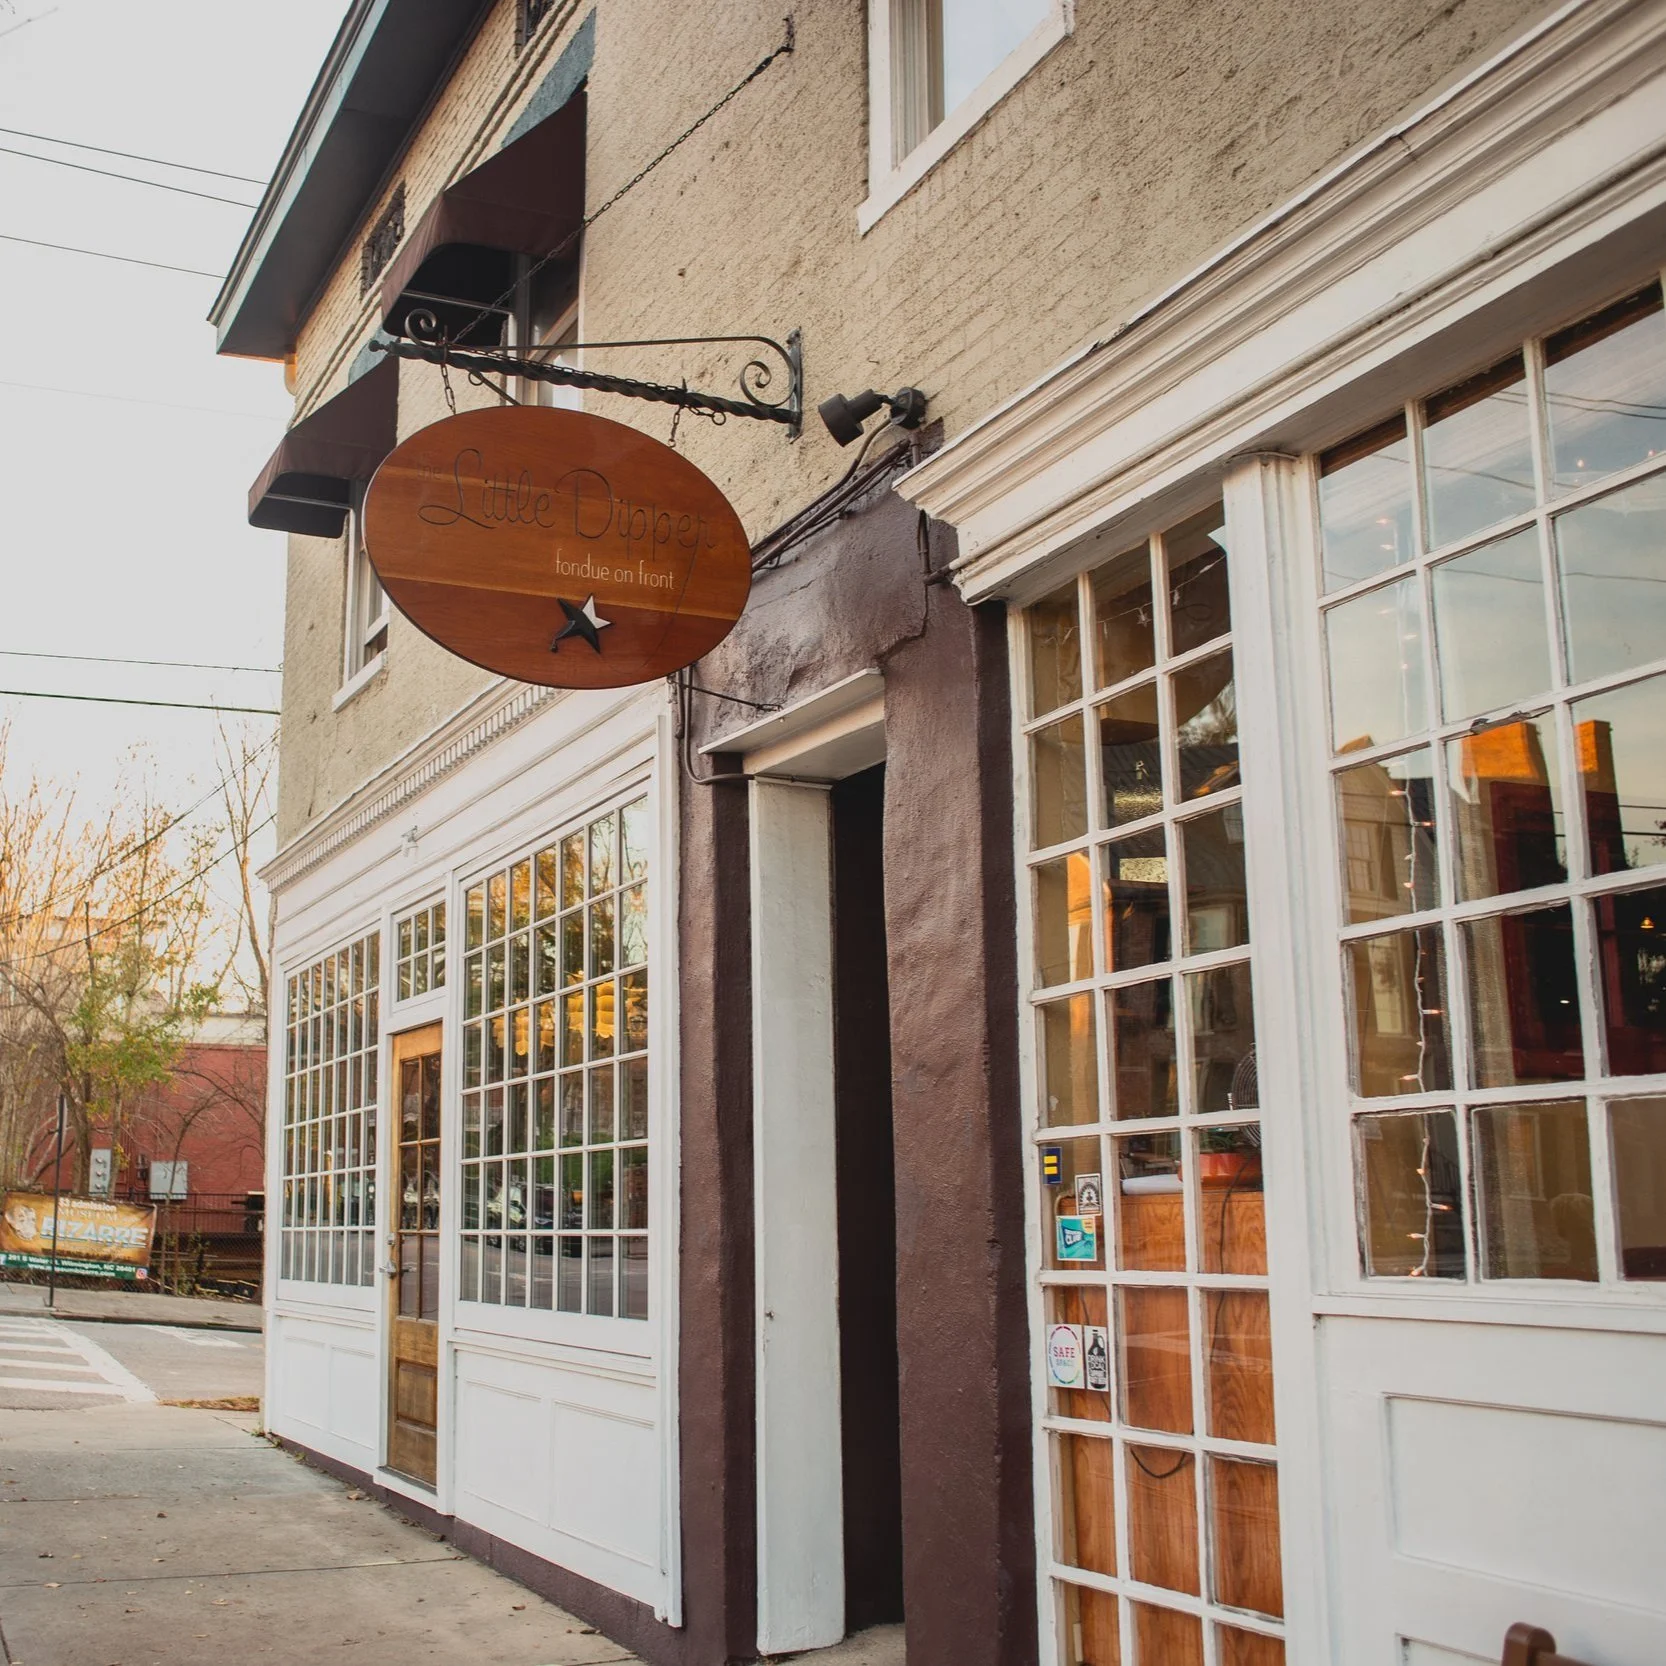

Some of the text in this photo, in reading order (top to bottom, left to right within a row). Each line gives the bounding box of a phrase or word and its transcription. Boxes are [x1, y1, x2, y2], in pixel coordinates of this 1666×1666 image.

[417, 448, 717, 562] Little Dipper
[556, 548, 675, 589] fondue on front
[71, 1199, 117, 1212] admission
[40, 1215, 149, 1247] BIZARRE
[103, 1263, 115, 1271] NC
[1053, 1346, 1076, 1358] SAFE
